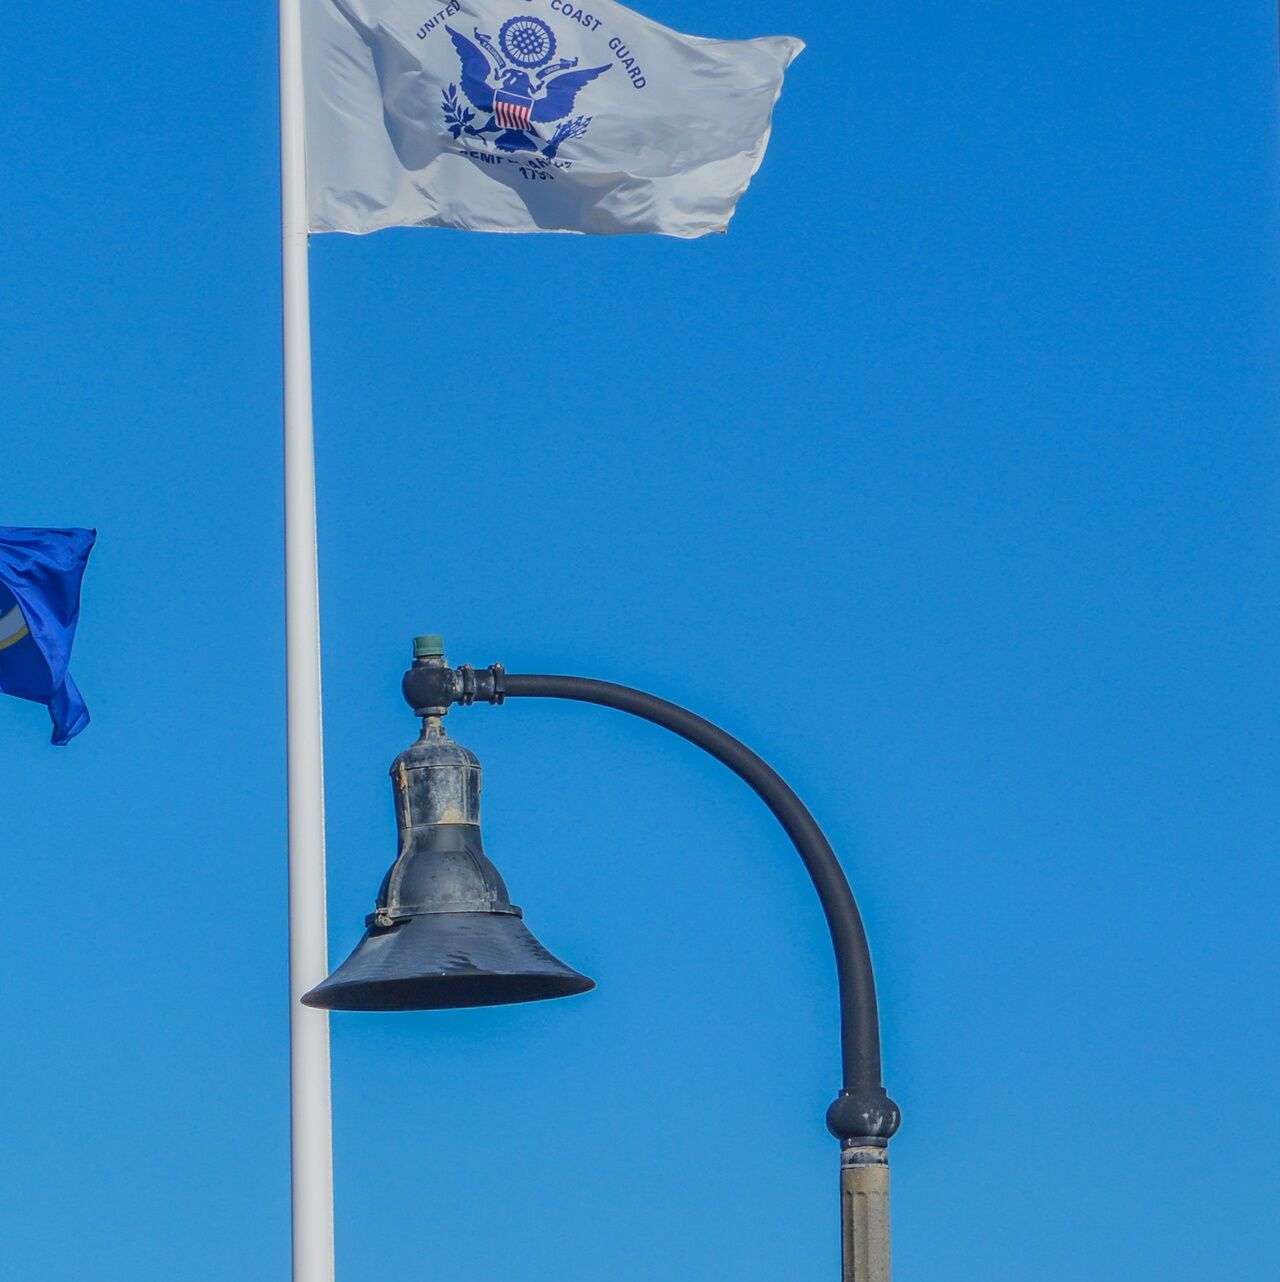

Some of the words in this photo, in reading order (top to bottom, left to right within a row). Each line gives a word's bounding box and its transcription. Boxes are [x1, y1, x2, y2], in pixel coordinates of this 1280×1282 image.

[416, 0, 461, 40] UNITED
[551, 0, 603, 32] COAST
[608, 37, 647, 90] GUARD
